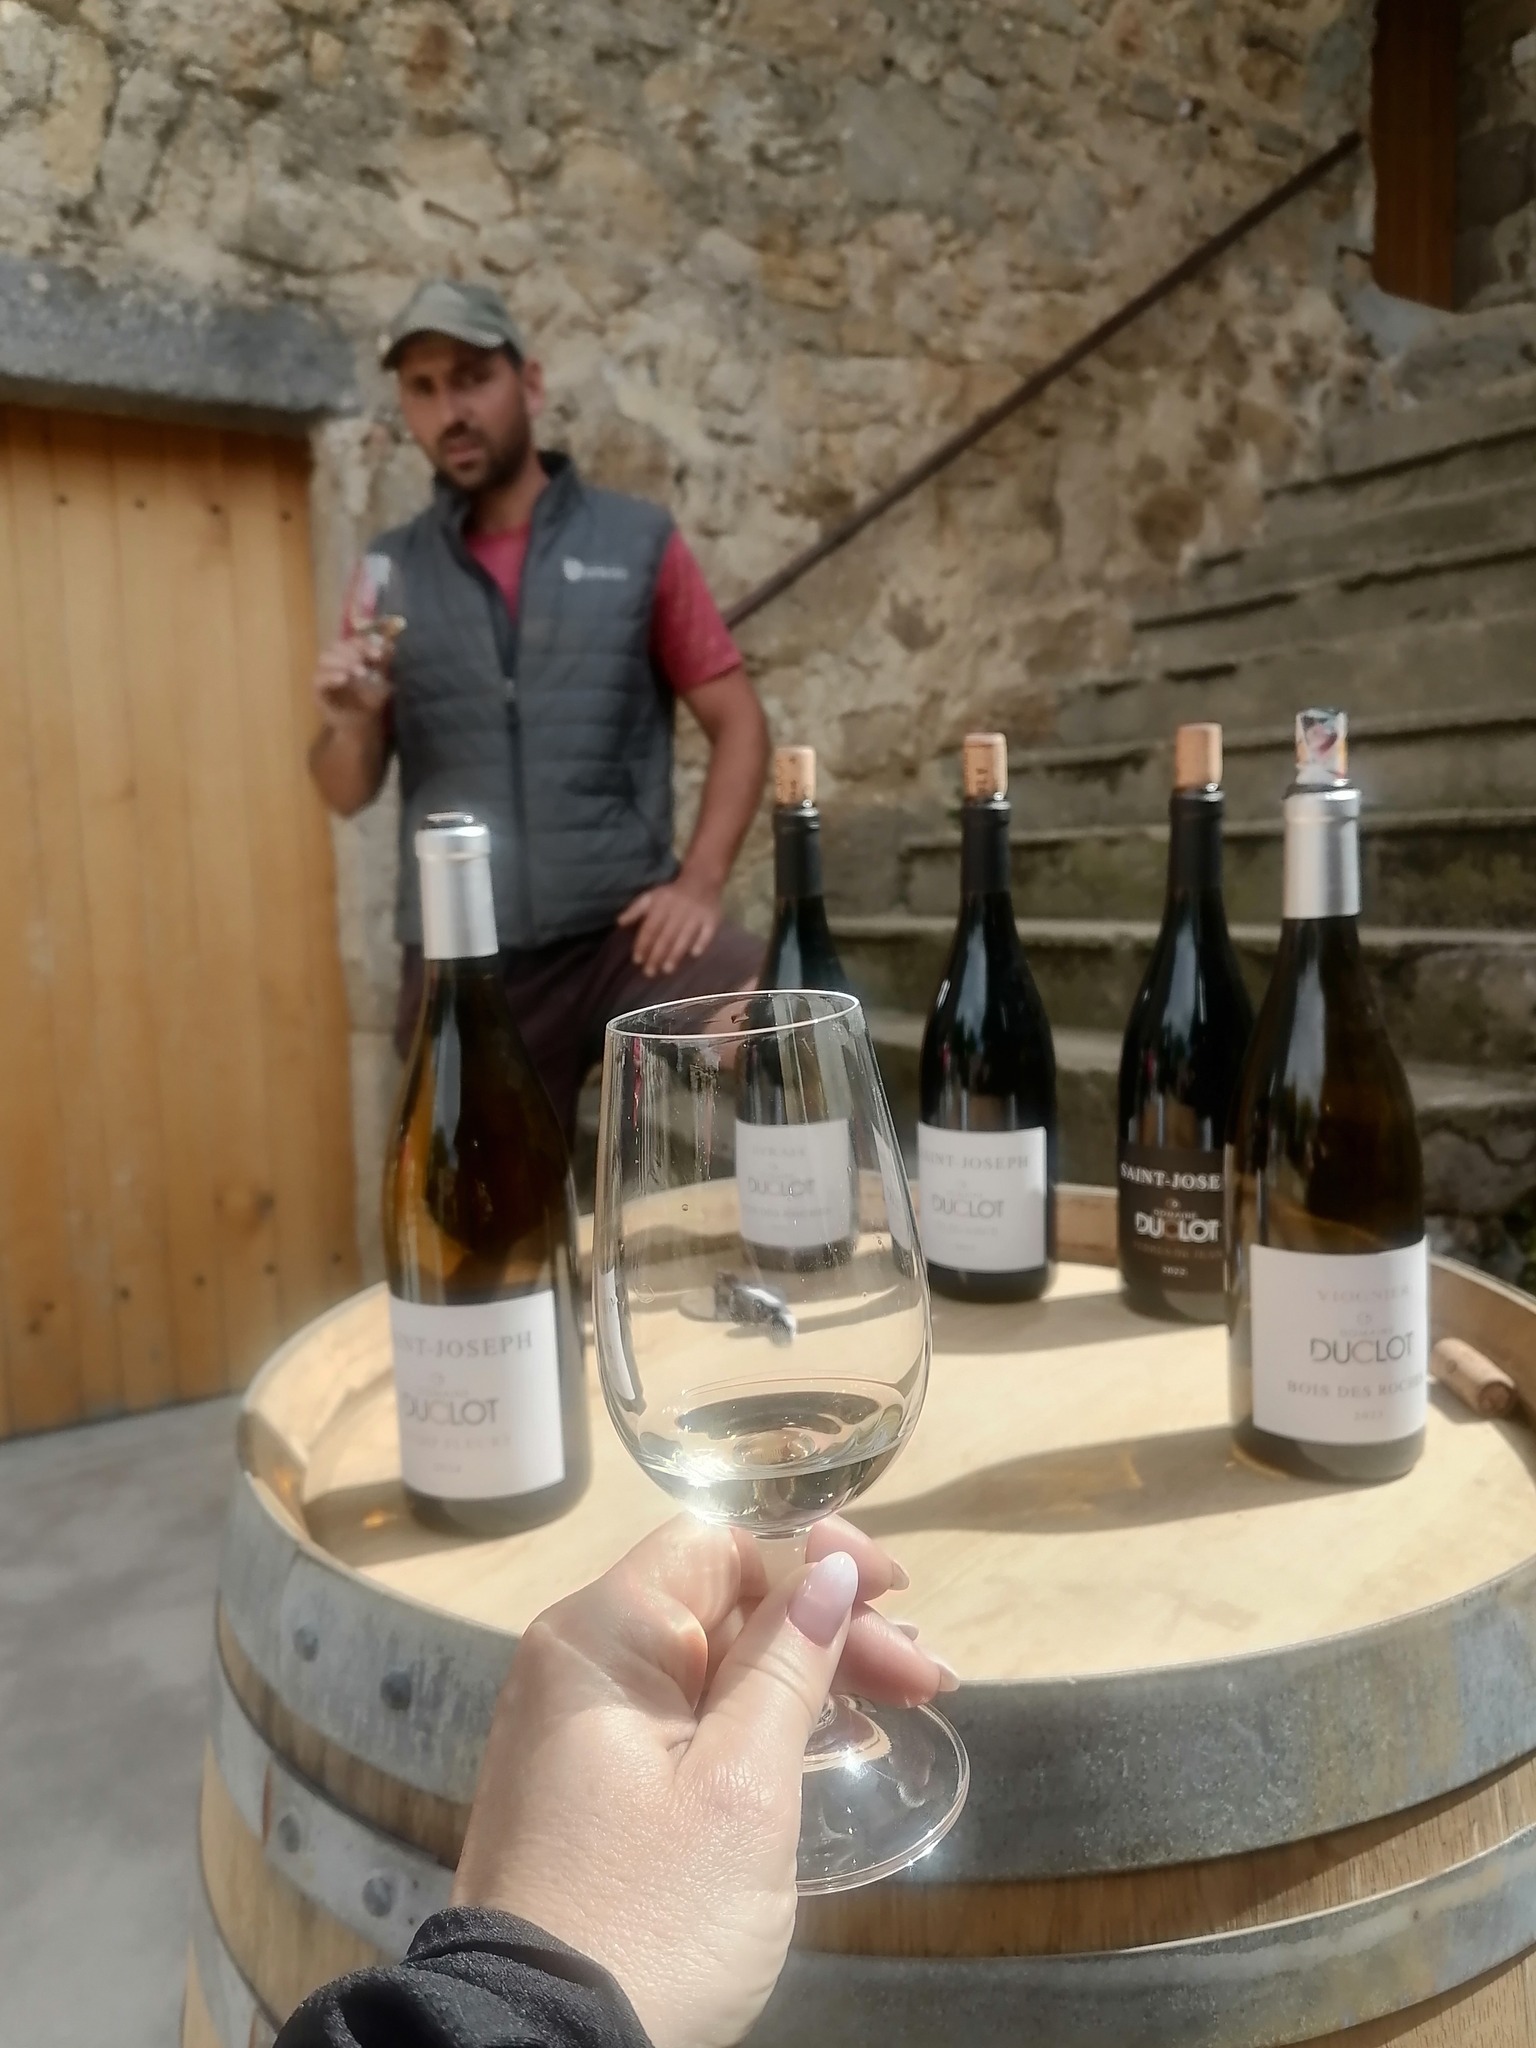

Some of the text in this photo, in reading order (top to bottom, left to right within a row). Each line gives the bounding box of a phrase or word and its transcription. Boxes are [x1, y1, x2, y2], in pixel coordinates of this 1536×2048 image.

[931, 1194, 1005, 1218] DUCLOT
[1153, 1208, 1198, 1220] DOMAINE
[1309, 1330, 1414, 1365] DUCLOT
[1287, 1380, 1329, 1397] BOIS
[1337, 1385, 1372, 1398] DES
